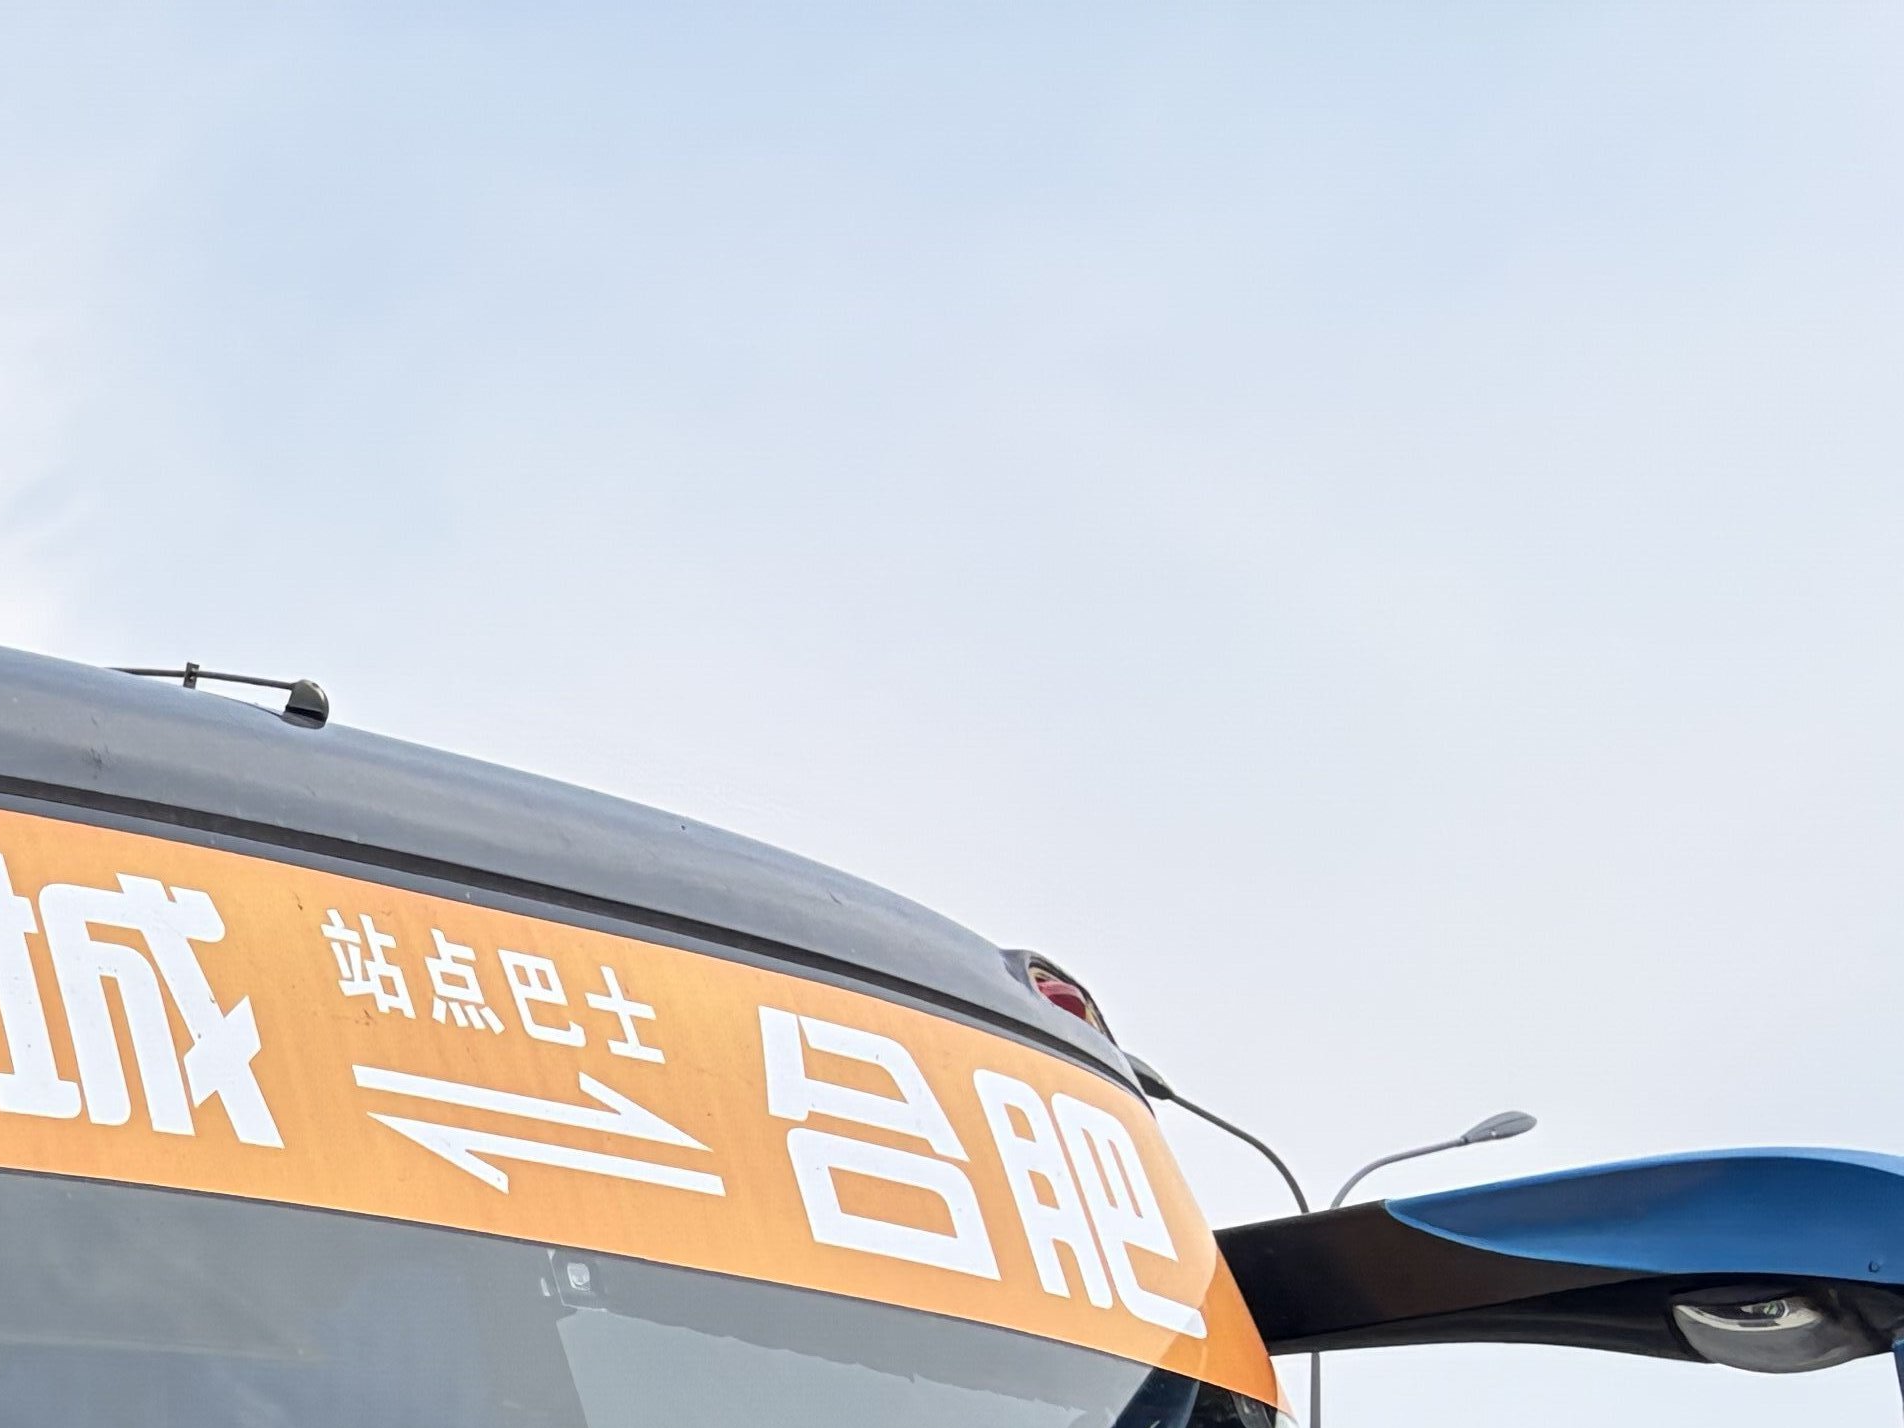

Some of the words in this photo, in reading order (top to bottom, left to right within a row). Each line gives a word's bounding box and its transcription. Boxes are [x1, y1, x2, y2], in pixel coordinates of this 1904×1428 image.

[321, 906, 666, 1067] 站点巴士
[758, 1003, 1206, 1341] 合肥
